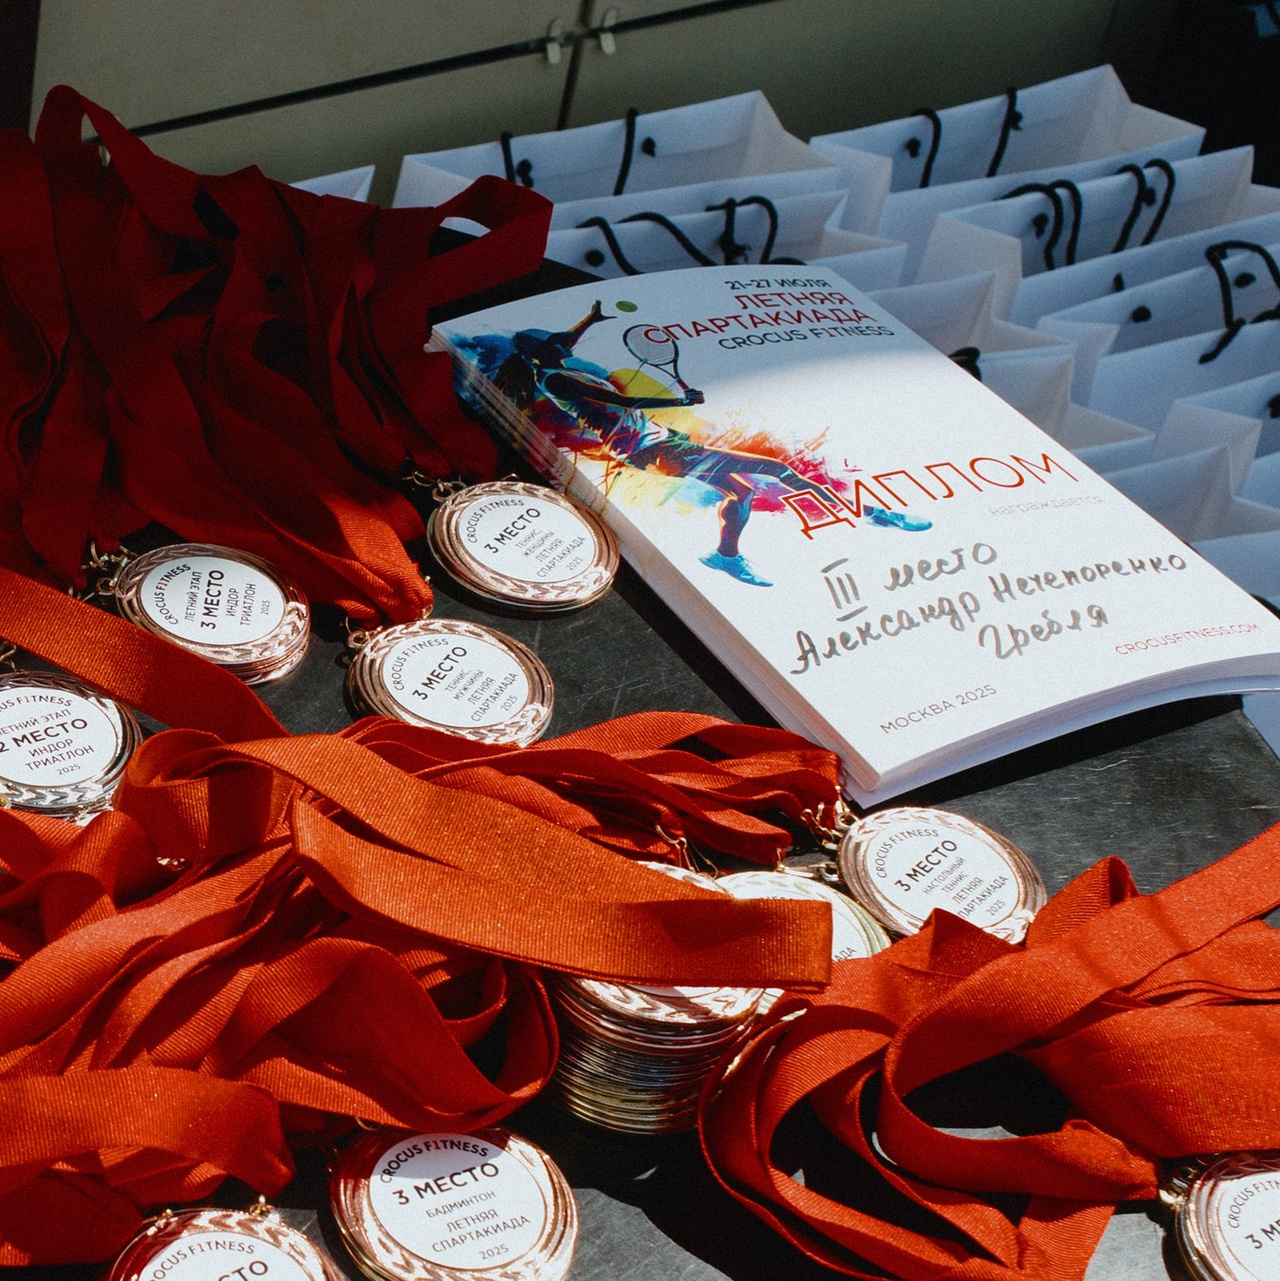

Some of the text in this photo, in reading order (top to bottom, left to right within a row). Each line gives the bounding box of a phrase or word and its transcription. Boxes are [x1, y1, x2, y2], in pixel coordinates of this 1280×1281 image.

[775, 279, 832, 288] ИЮЛЯ
[734, 292, 854, 309] ЛЕТНЯЯ
[643, 308, 877, 344] СПАРТАКИАДА
[718, 330, 806, 350] CROCUS
[781, 452, 1079, 540] ДИПЛОМ
[988, 496, 1106, 517] награждается
[466, 512, 483, 543] CROCUS
[484, 508, 540, 554] 3 МЕСТО
[536, 537, 564, 562] ЛЕТНЯЯ
[537, 536, 586, 578] СПАРТАКИАДА
[155, 592, 178, 625] CROCUS
[185, 571, 202, 622] ЛЕТНИЙ ЭТАП
[203, 570, 224, 618] МЕСТО
[225, 588, 240, 617] ИНДОР
[240, 583, 256, 626] ТРИАТЛОН
[261, 600, 270, 615] 2025
[790, 591, 981, 675] Александр
[1114, 622, 1260, 656] CROCUSFITNESS.COM
[392, 656, 406, 691] CROCUS
[412, 646, 467, 700] 3 МЕСТО
[468, 677, 496, 705] ЛЕТНЯЯ
[471, 673, 518, 722] СПАРТАКИАДА
[501, 695, 518, 712] 2025
[41, 709, 71, 723] ЭТАП
[880, 684, 997, 735] МОСКВА 2025
[12, 719, 88, 748] МЕСТО
[29, 739, 73, 757] ИНДОР
[26, 745, 94, 771] ТРИАТЛОН
[57, 764, 81, 775] 2025
[875, 843, 893, 878] CROCUS
[895, 840, 957, 892] 3 МЕСТО
[922, 857, 966, 895] НАСТОЛЬНЫЙ
[941, 871, 970, 893] ТЕННИС
[952, 877, 984, 904] ЛЕТНЯЯ
[986, 900, 1006, 916] 2025
[380, 1145, 423, 1184] CROCUS
[392, 1162, 499, 1205] 3 МЕСТО
[426, 1190, 497, 1218] БАДМИНТОН
[1228, 1187, 1255, 1229] CROCUS
[432, 1215, 530, 1253] СПАРТАКИАДА
[446, 1209, 499, 1232] ЛЕТНЯЯ
[479, 1244, 509, 1260] 2025
[1245, 1234, 1263, 1249] 3
